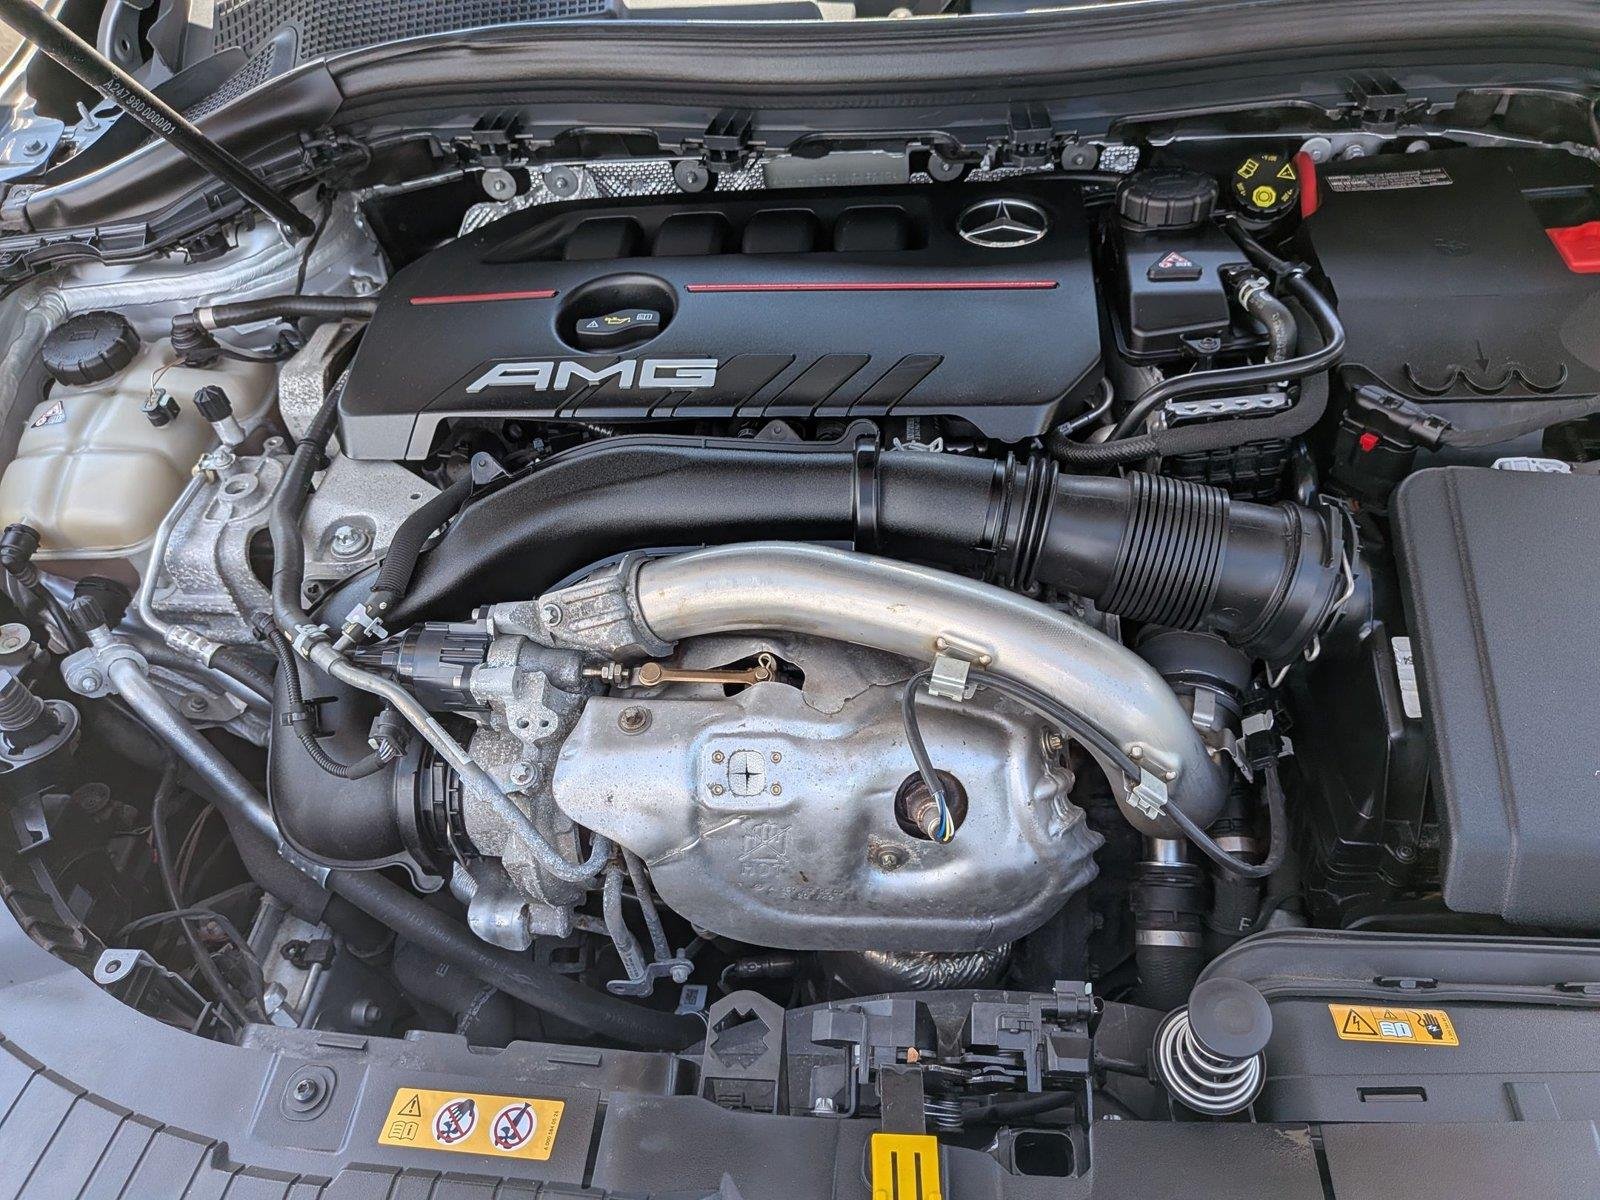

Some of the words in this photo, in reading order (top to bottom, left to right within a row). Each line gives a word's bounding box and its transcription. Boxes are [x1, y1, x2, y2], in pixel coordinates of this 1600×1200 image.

[103, 80, 130, 99] A247
[126, 95, 146, 112] 980
[142, 107, 176, 135] 0000/01
[466, 359, 719, 394] AMG
